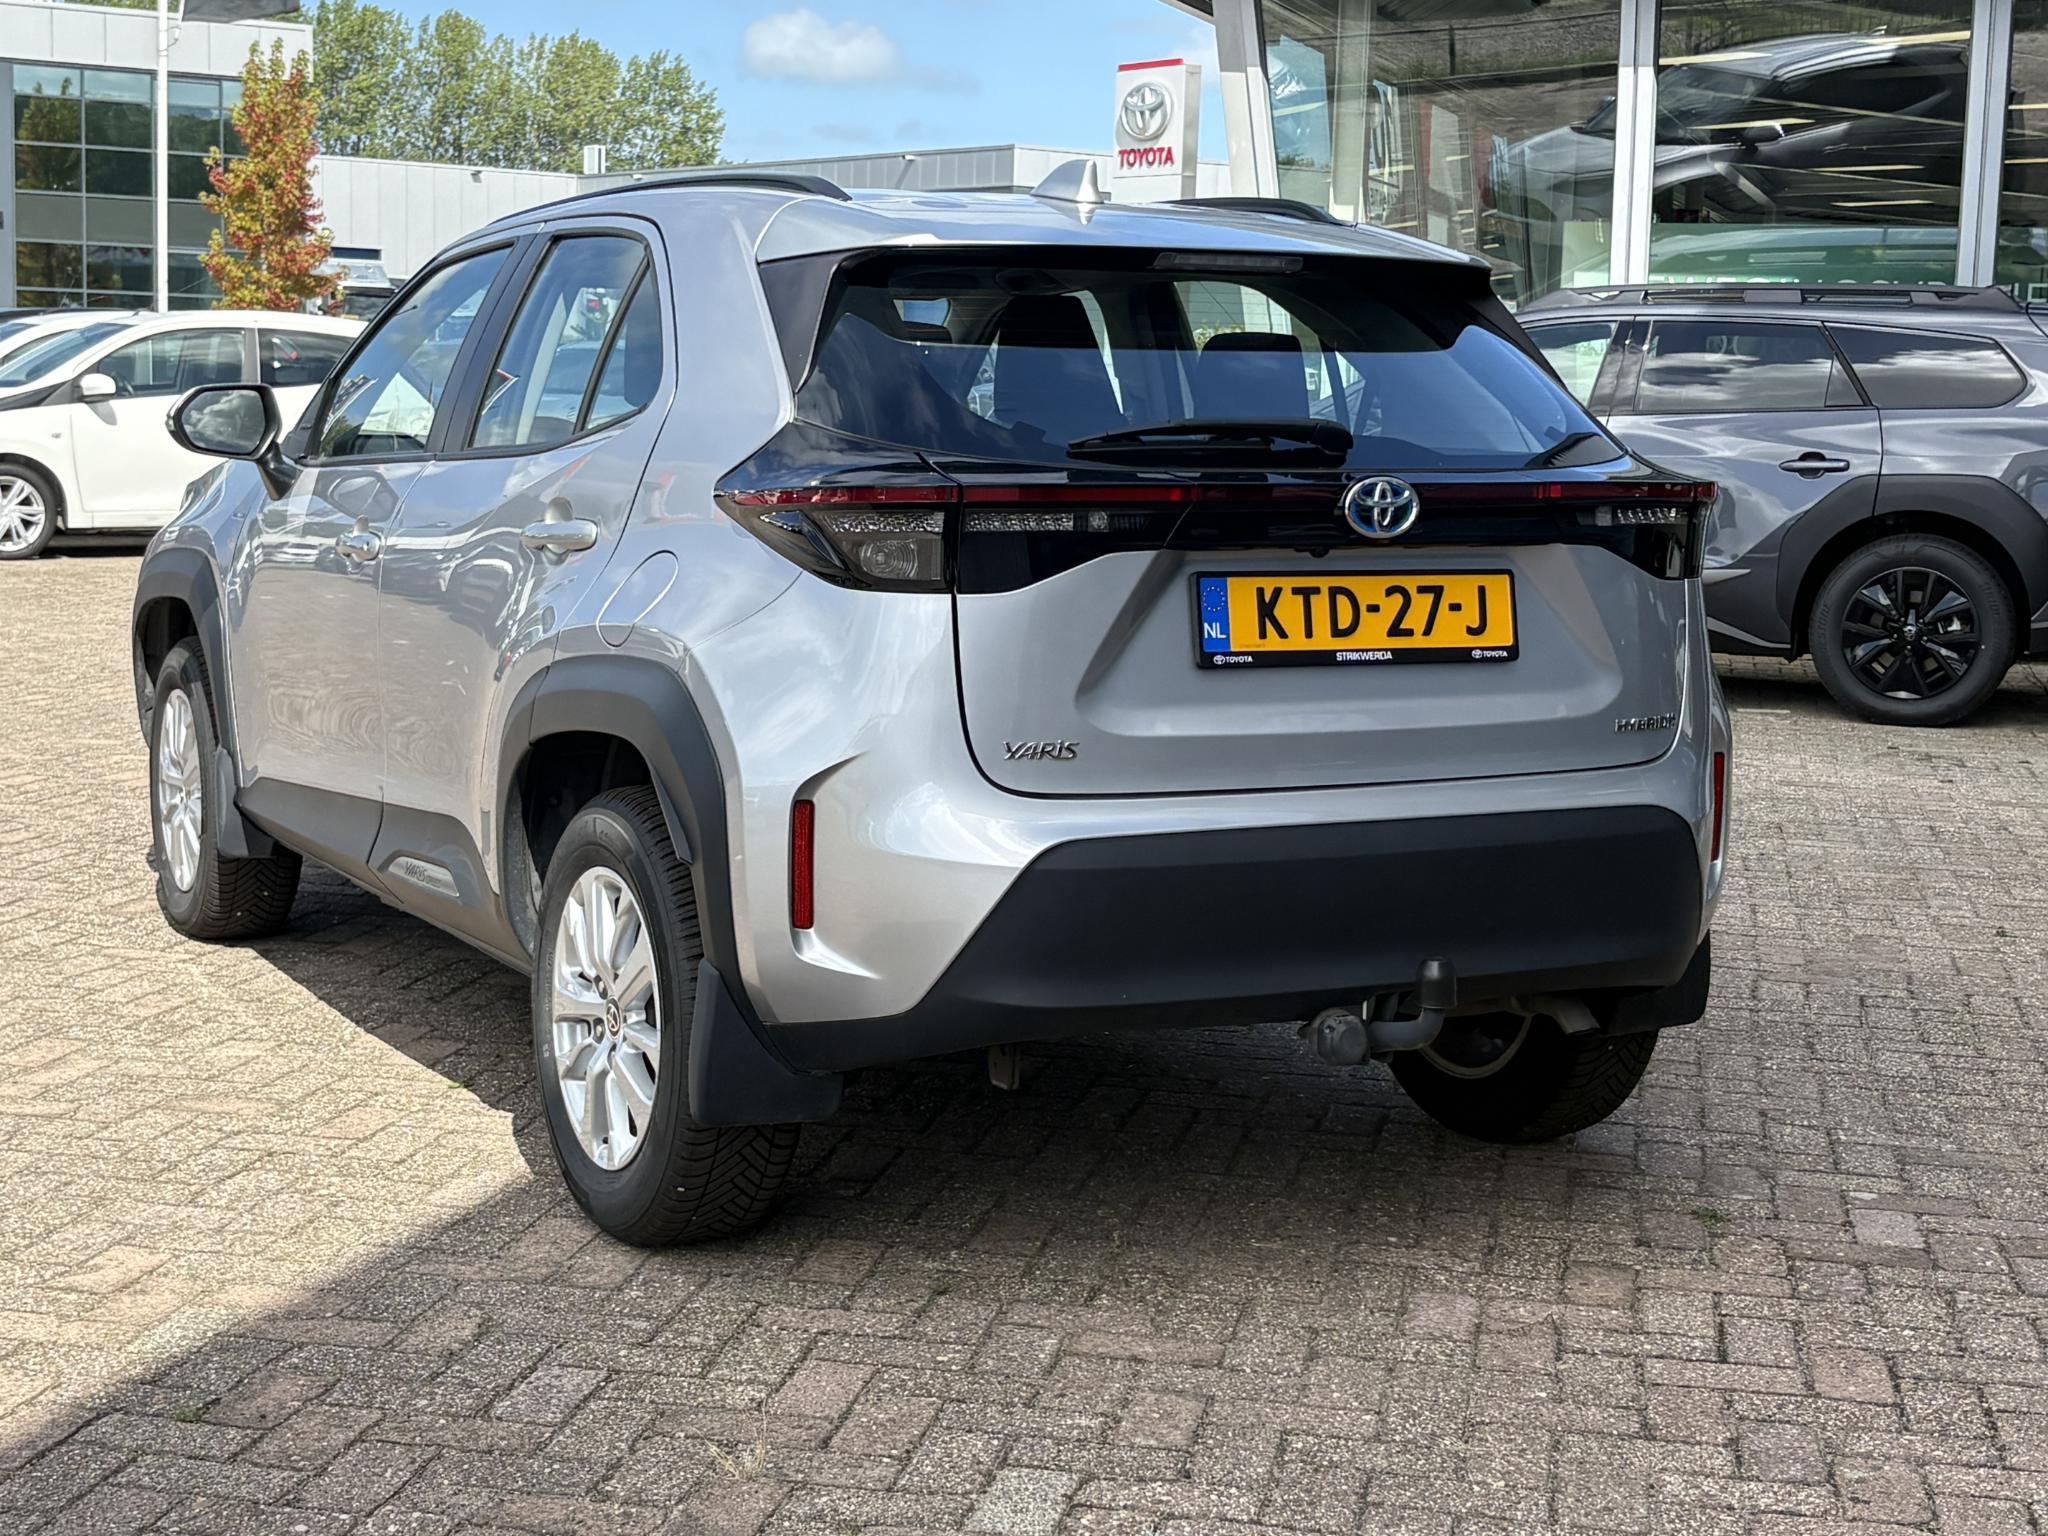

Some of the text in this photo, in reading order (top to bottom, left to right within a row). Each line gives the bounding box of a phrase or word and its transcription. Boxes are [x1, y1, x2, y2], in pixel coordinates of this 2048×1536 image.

[1118, 147, 1175, 169] TOYOTA
[1255, 585, 1488, 640] KTD-27-J
[1204, 622, 1227, 640] NL
[1225, 655, 1253, 663] TOYOTA
[1336, 651, 1393, 662] STRIKWERDA
[1482, 650, 1508, 658] TOYOTA
[1615, 712, 1676, 732] HYBRID
